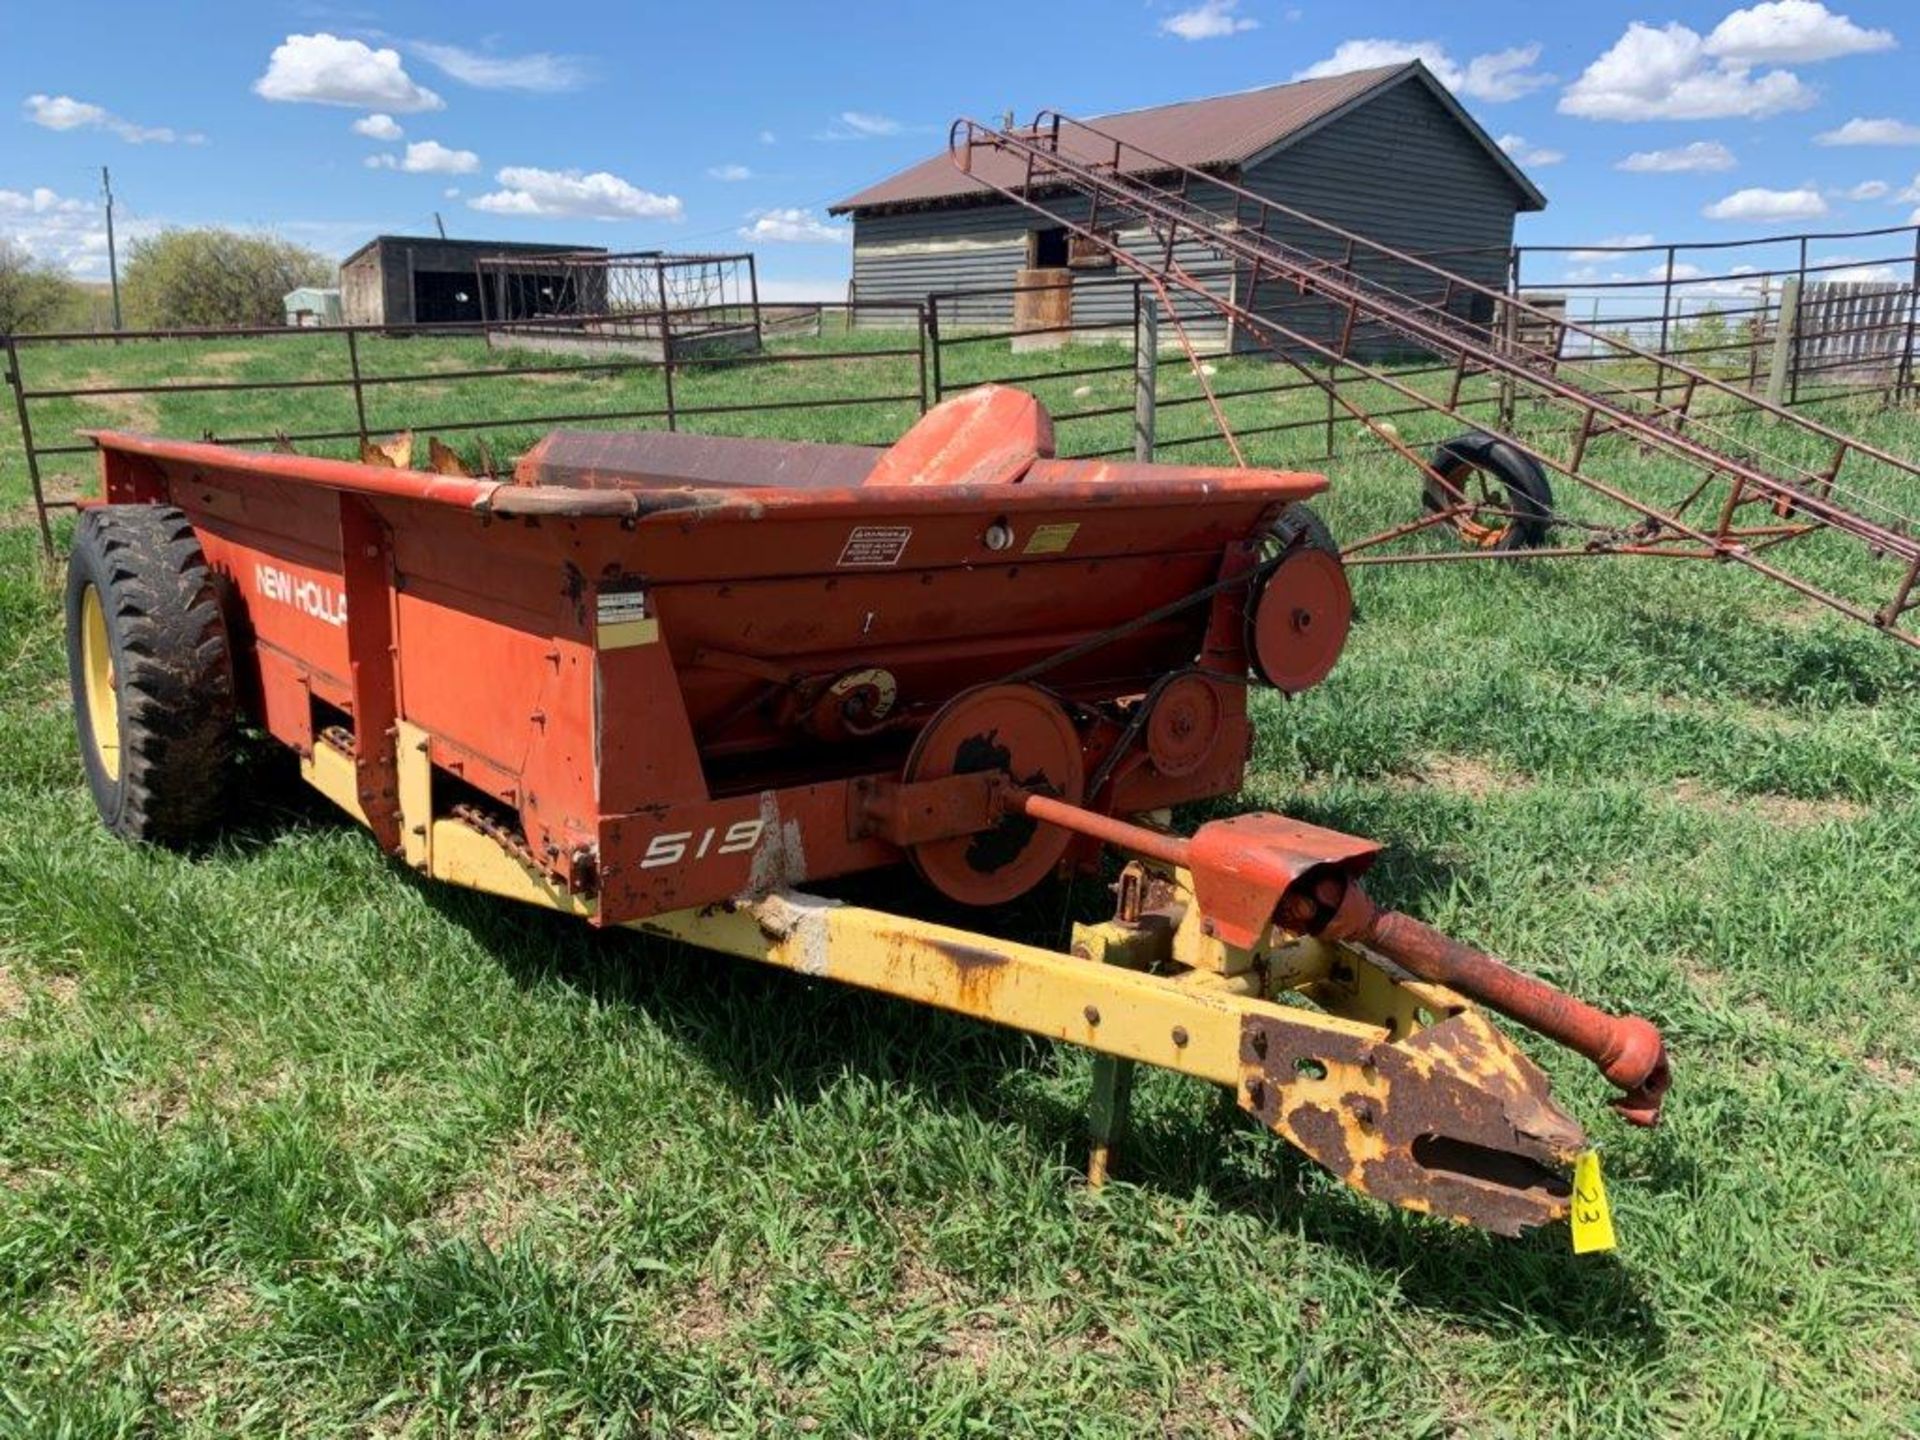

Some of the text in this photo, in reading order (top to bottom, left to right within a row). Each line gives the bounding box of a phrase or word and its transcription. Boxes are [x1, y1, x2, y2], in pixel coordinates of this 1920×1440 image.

[255, 564, 292, 605] NEW
[640, 821, 765, 869] 519
[1576, 1187, 1600, 1225] 23
